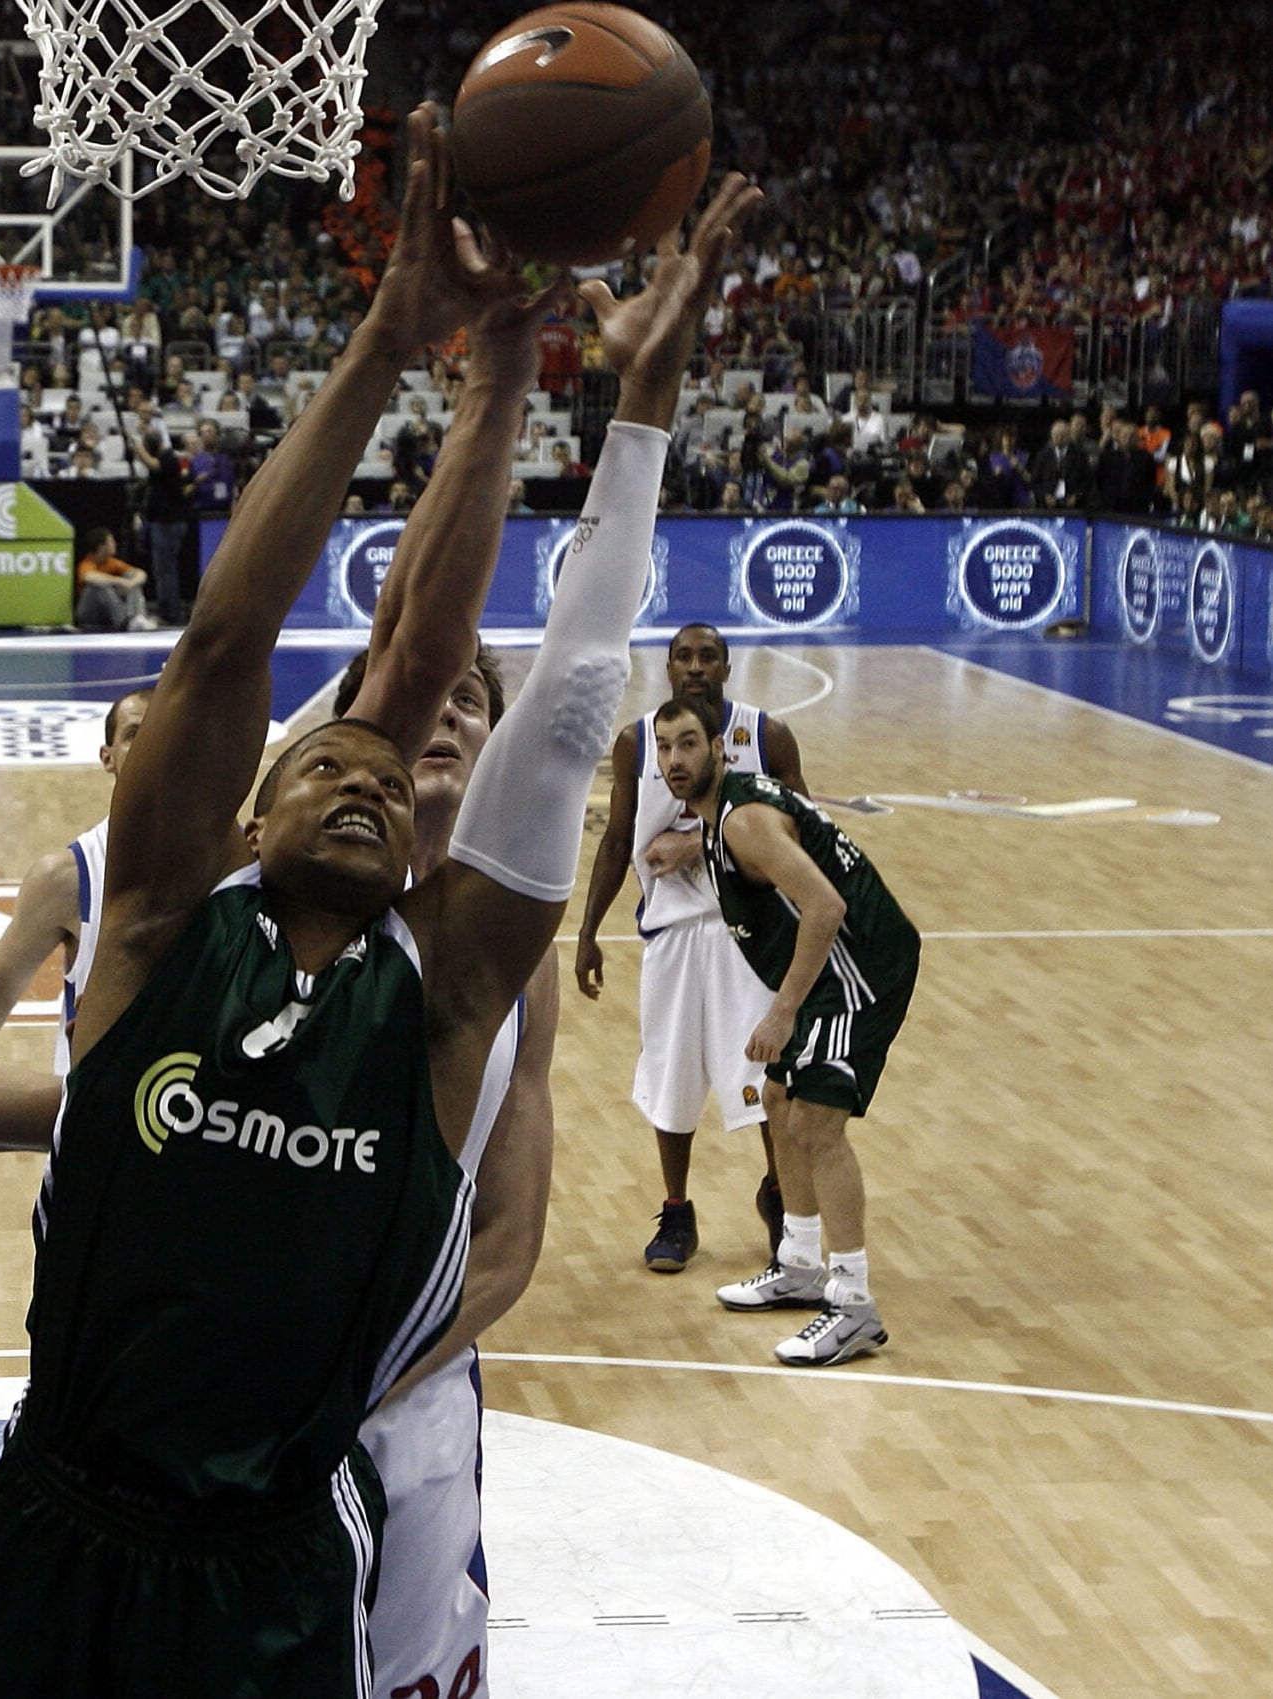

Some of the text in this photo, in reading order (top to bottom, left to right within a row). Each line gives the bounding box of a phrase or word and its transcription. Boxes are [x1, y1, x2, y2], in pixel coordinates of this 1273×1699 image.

[766, 545, 825, 562] GREECE
[984, 545, 1042, 562] GREECE
[773, 563, 817, 580] 5000
[991, 563, 1034, 580] 5000
[775, 581, 814, 598] years
[992, 581, 1031, 598] years
[782, 596, 806, 612] old
[999, 595, 1023, 612] old
